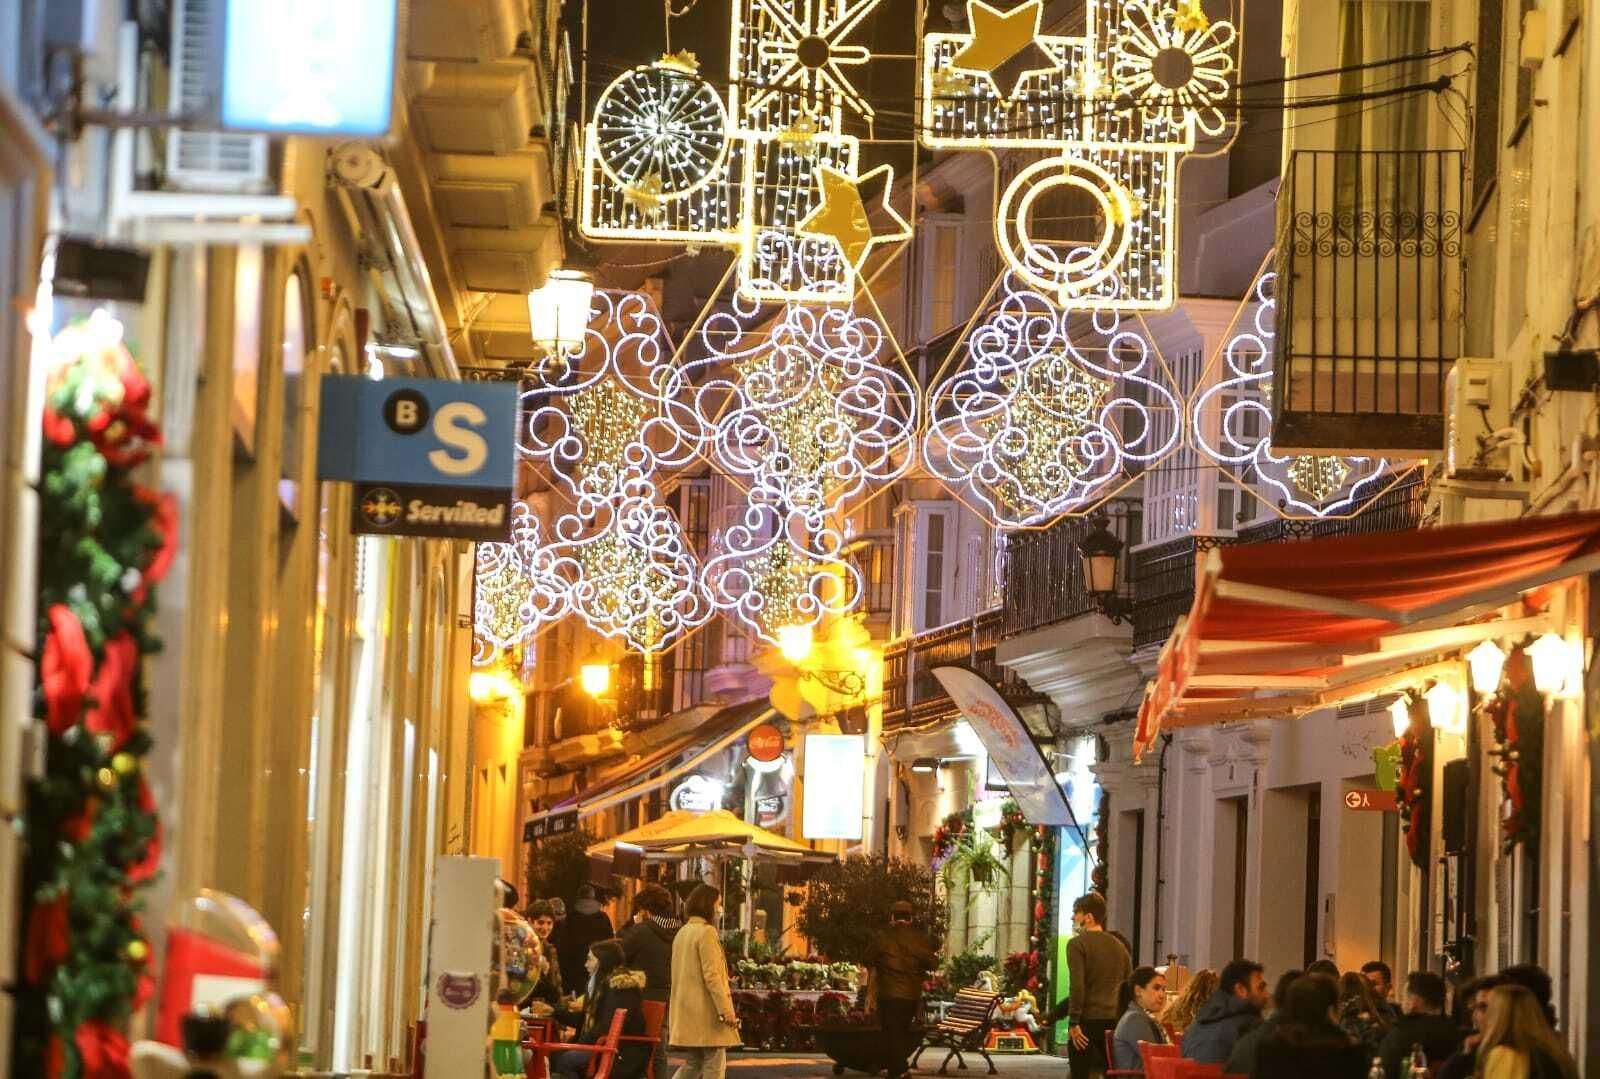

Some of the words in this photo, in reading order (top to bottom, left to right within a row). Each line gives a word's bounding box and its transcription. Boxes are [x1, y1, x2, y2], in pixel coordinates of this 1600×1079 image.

[396, 400, 418, 425] B
[429, 401, 488, 476] S
[406, 499, 505, 525] ServiRed
